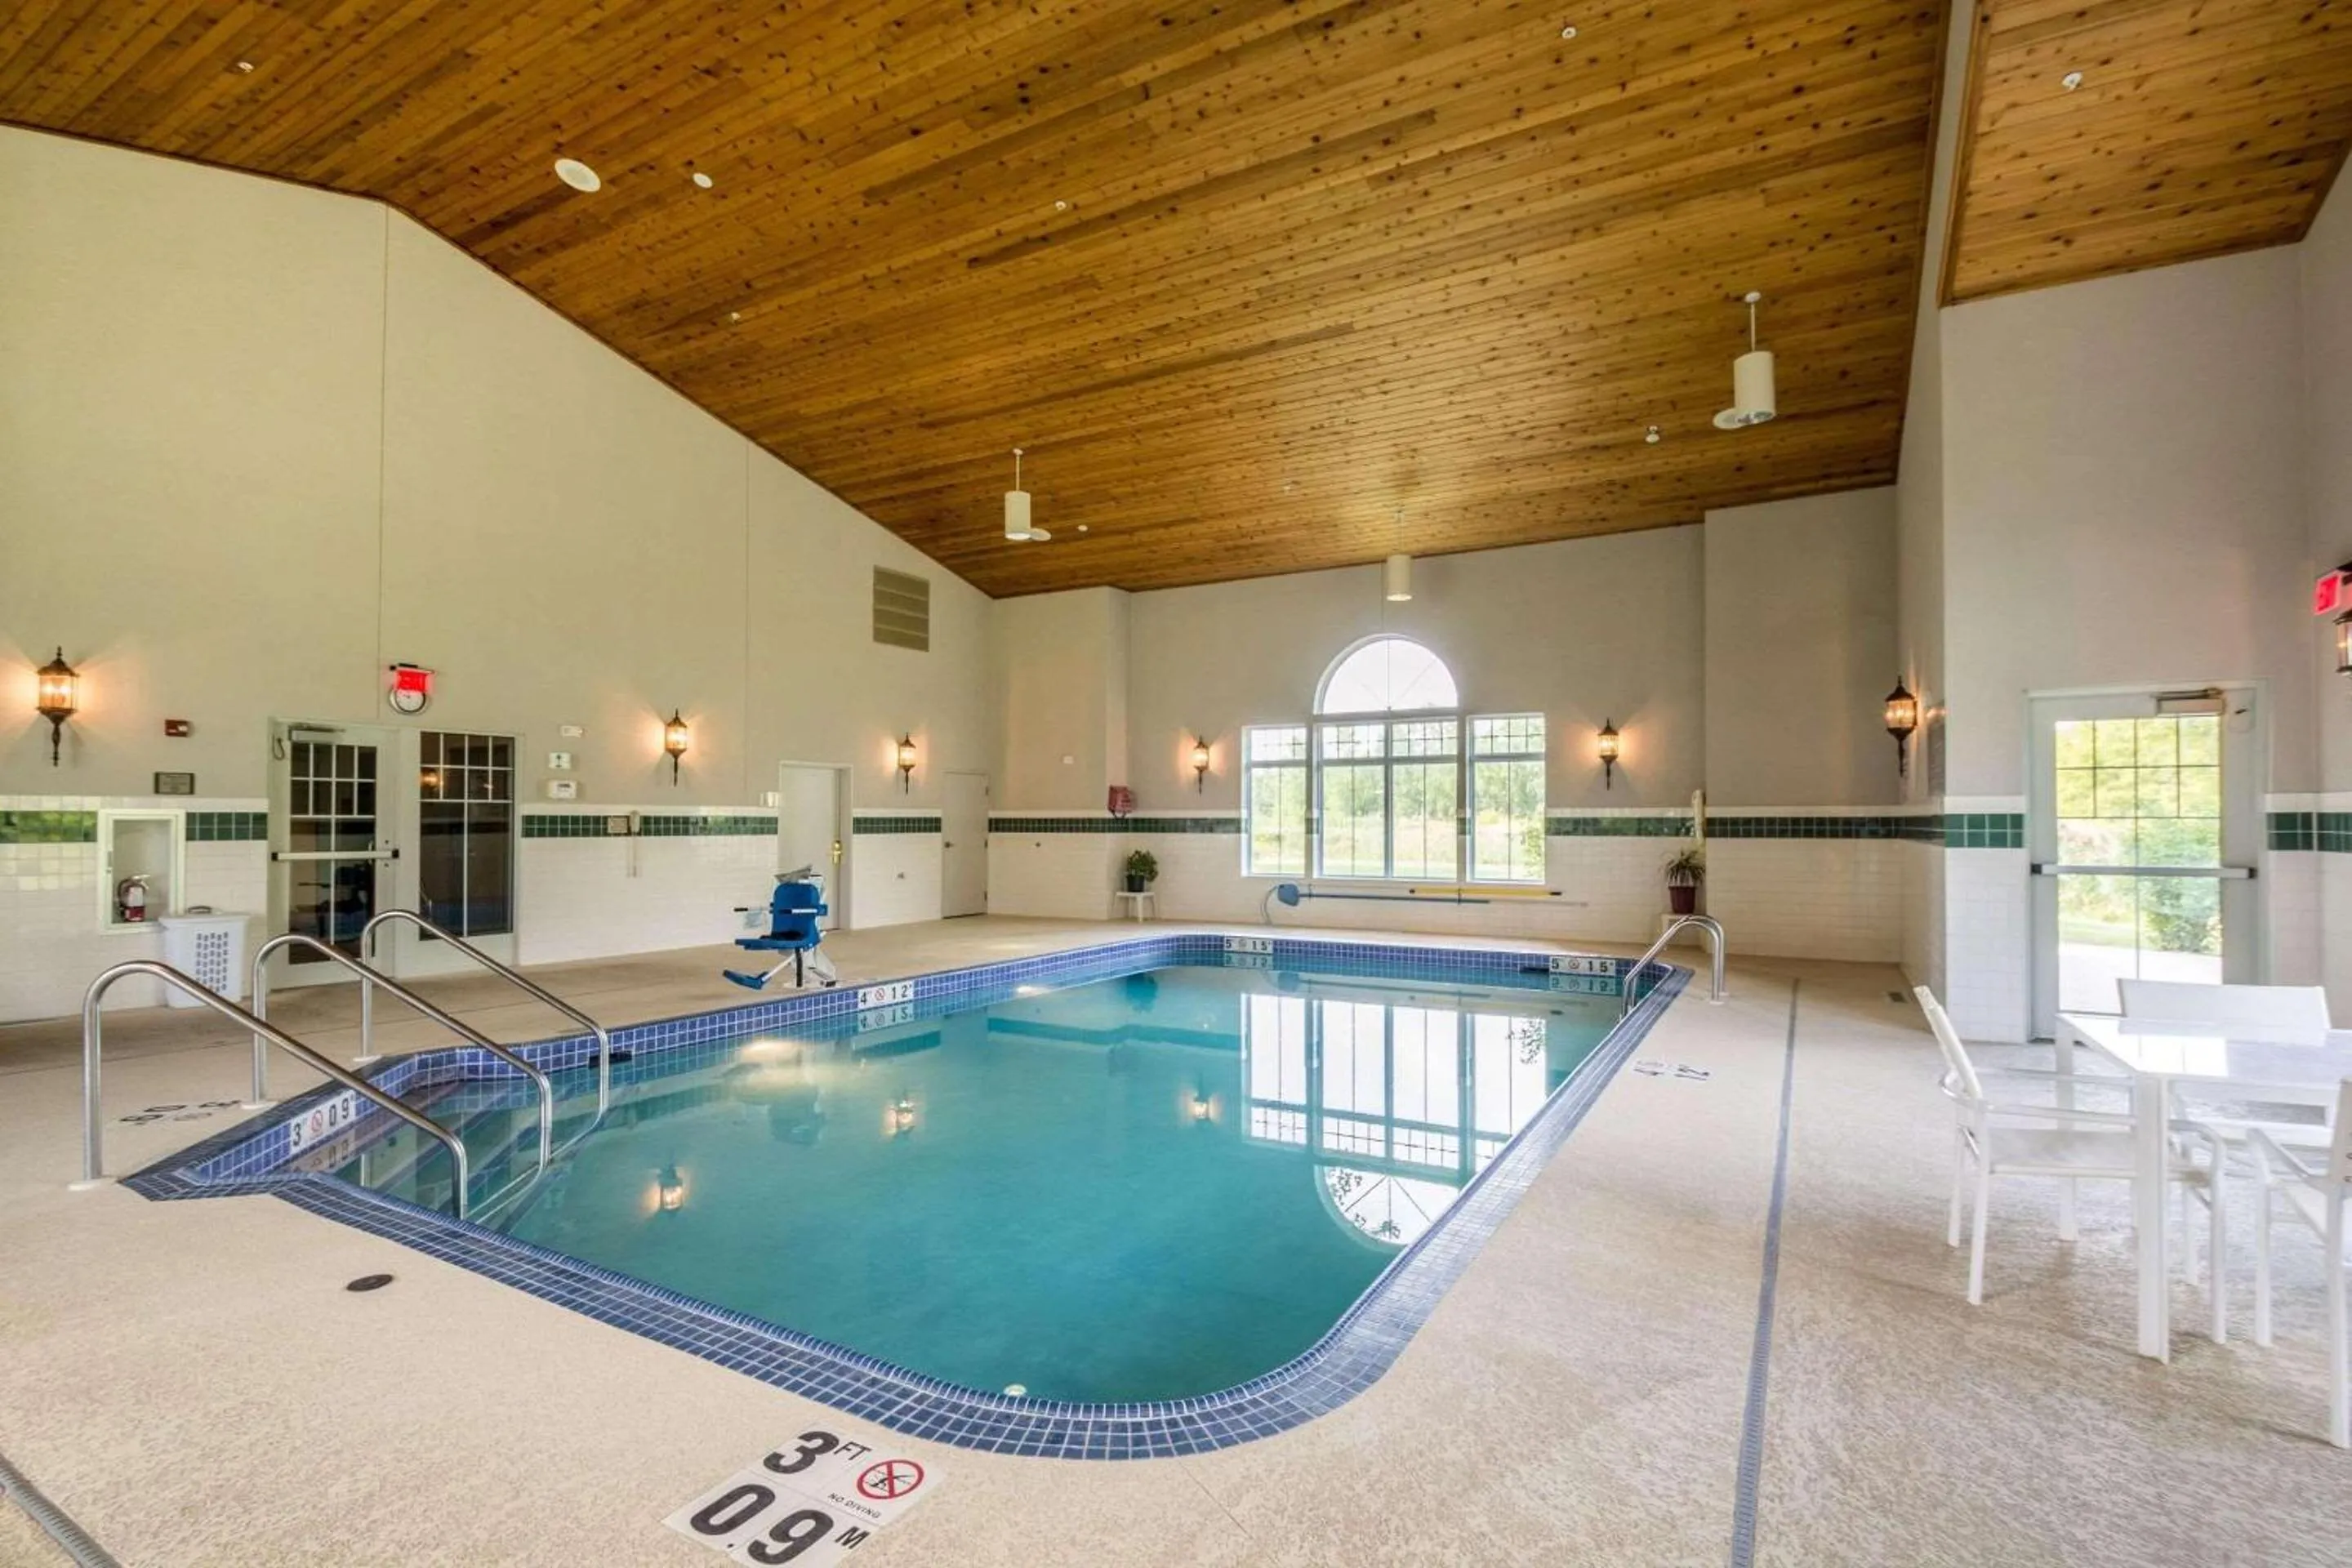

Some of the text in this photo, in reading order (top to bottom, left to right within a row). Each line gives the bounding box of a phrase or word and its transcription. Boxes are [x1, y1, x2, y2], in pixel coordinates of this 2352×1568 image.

[860, 991, 867, 1004] 4
[293, 1123, 301, 1147] 3
[763, 1430, 871, 1475] 3 FT
[827, 1492, 881, 1519] NO DIVING
[835, 1526, 870, 1549] M
